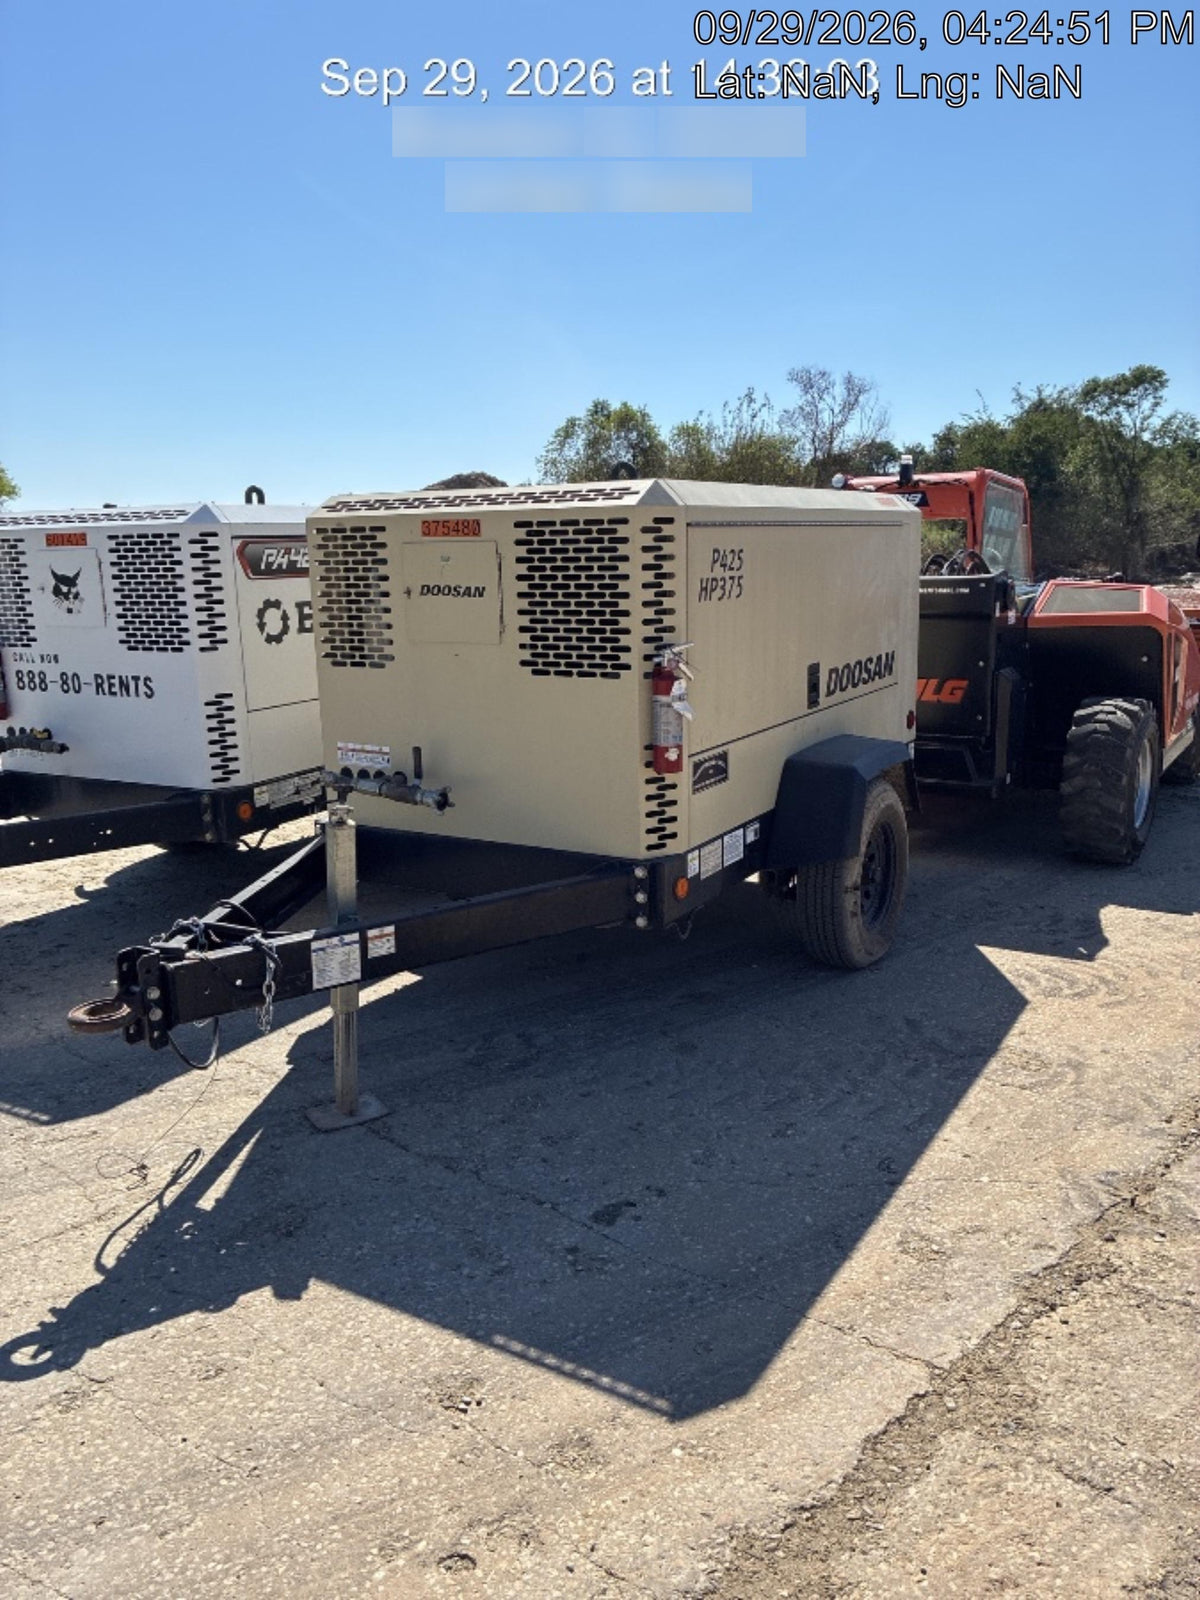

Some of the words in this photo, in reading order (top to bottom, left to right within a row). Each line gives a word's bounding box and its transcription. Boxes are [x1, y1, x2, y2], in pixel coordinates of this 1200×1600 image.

[711, 548, 744, 573] P425
[420, 584, 486, 598] DOOSAN
[698, 575, 744, 603] HP375
[15, 669, 155, 699] 888-80-RENTS
[825, 650, 896, 698] DOOSAN
